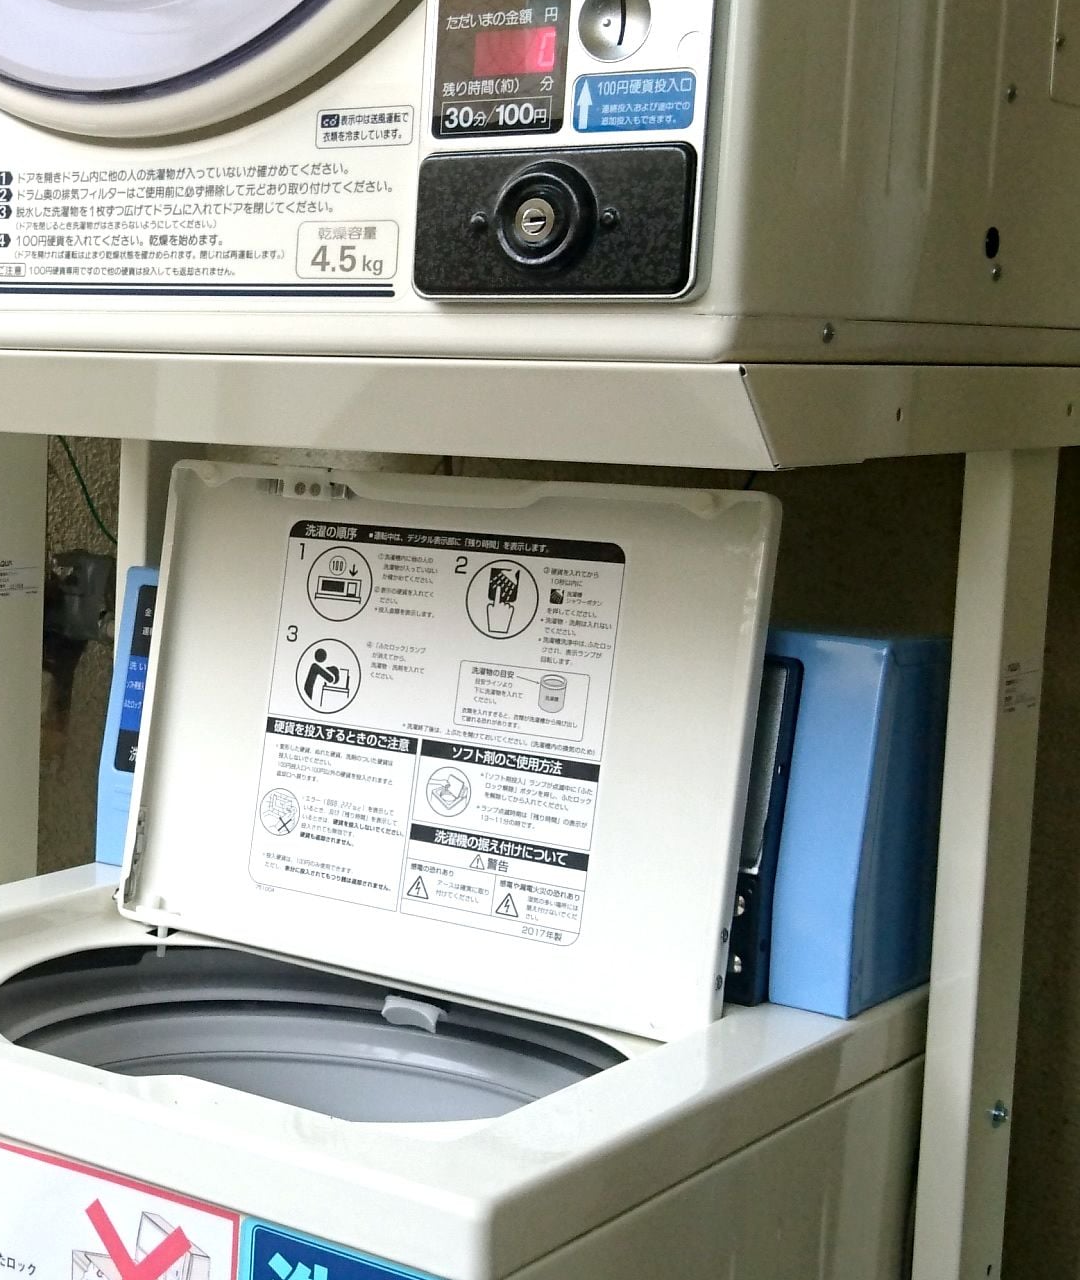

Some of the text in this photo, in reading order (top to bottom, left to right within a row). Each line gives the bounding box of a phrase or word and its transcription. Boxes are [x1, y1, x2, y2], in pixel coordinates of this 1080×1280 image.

[446, 7, 558, 30] ただいまの金額 円
[540, 76, 553, 91] 分
[597, 77, 692, 96] 100円硬貨投入口
[445, 103, 547, 130] 30分/100円
[318, 226, 376, 240] 乾燥容量
[311, 245, 383, 274] 4.5 kg
[305, 524, 357, 540] 洗濯の順序
[299, 543, 306, 560] 1
[454, 556, 467, 573] 2
[287, 626, 298, 642] 3
[274, 720, 410, 752] 硬貨を投入するときのご注意
[452, 745, 563, 775] ソフト剤のご使用方法
[435, 830, 568, 866] 洗濯機の据え付けについて
[487, 857, 509, 872] 警告
[522, 926, 562, 941] 2017年製
